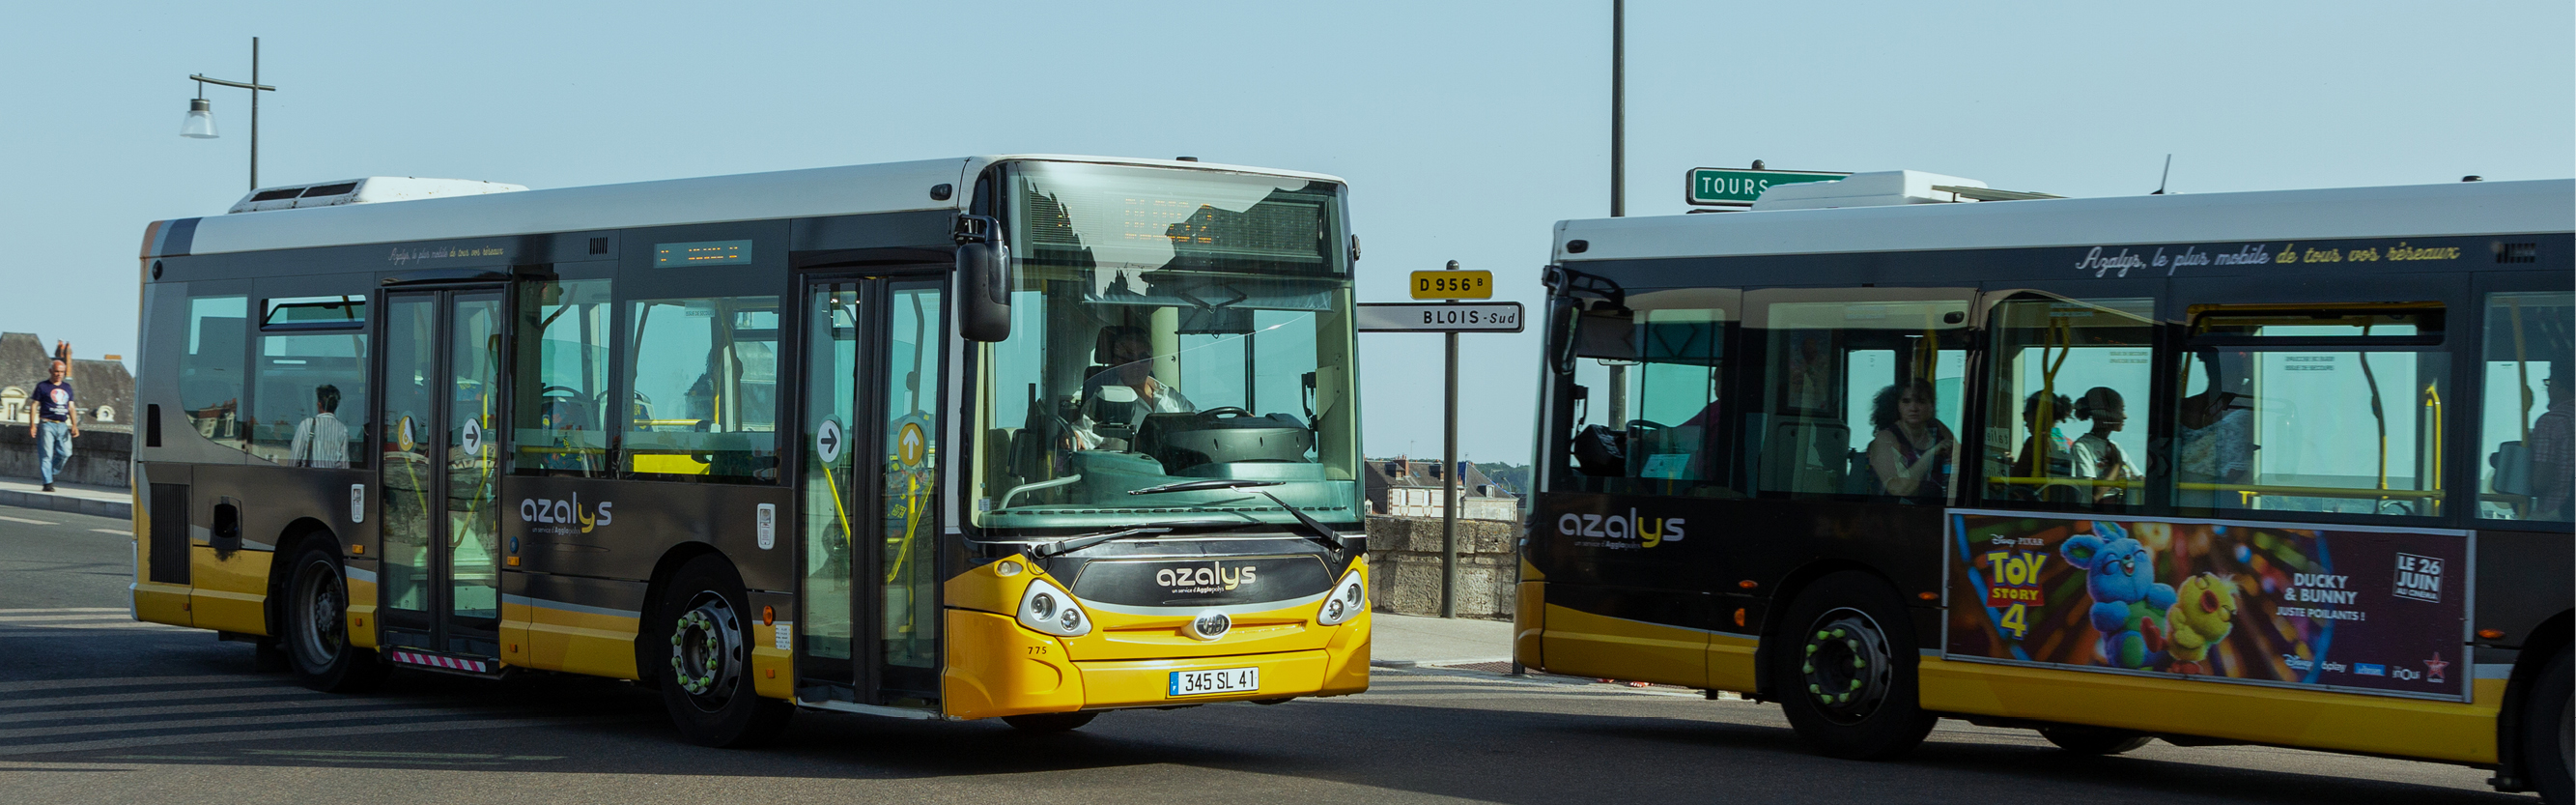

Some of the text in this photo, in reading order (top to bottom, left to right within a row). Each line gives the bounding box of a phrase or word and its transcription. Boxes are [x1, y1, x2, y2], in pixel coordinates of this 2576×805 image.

[1703, 177, 1769, 195] TOURS
[2151, 247, 2168, 267] le
[2167, 245, 2210, 276] plus
[2214, 244, 2270, 266] mobile
[2275, 244, 2298, 264] de
[2303, 247, 2342, 263] tous
[2348, 247, 2380, 262] vos
[2385, 242, 2460, 261] réseaux
[1420, 278, 1430, 291] D
[1436, 278, 1470, 291] 956
[521, 491, 612, 533] azalys
[1558, 506, 1685, 548] azalys
[2398, 556, 2441, 574] LE 26
[1156, 561, 1257, 590] azalys
[2294, 573, 2348, 589] DUCKY
[2396, 571, 2440, 591] JUIN
[1993, 588, 2039, 600] STORY
[2284, 588, 2358, 605] & BUNNY
[2000, 601, 2028, 640] 4
[2276, 607, 2306, 618] JUSTE
[2307, 608, 2359, 620] POILANTS
[1185, 670, 1254, 691] 345 SL 41
